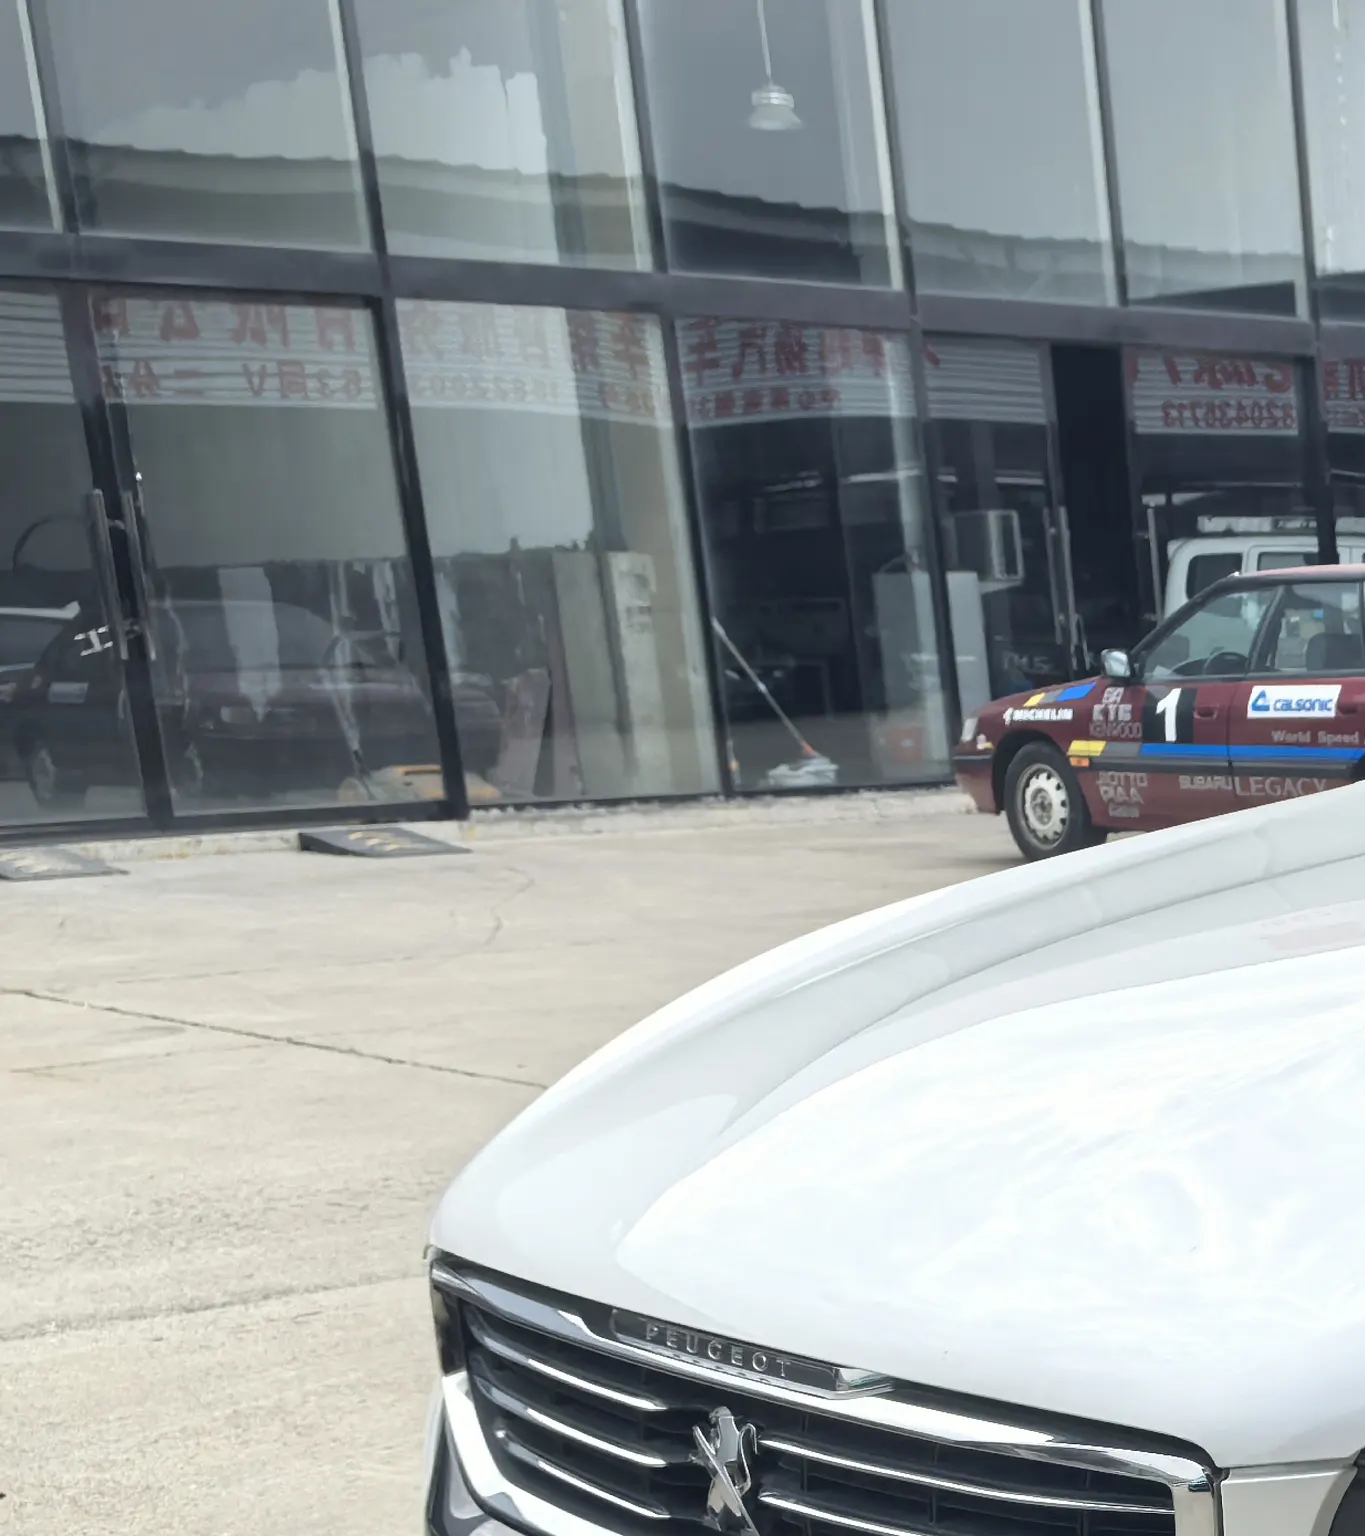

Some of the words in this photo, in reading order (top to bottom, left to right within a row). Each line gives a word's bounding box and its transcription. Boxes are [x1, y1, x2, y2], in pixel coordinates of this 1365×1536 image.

[1155, 687, 1182, 742] 1
[1271, 730, 1311, 744] World
[1178, 774, 1233, 790] SUBARU
[1234, 776, 1327, 799] LEGACY
[645, 1321, 790, 1378] PEUGEOT
